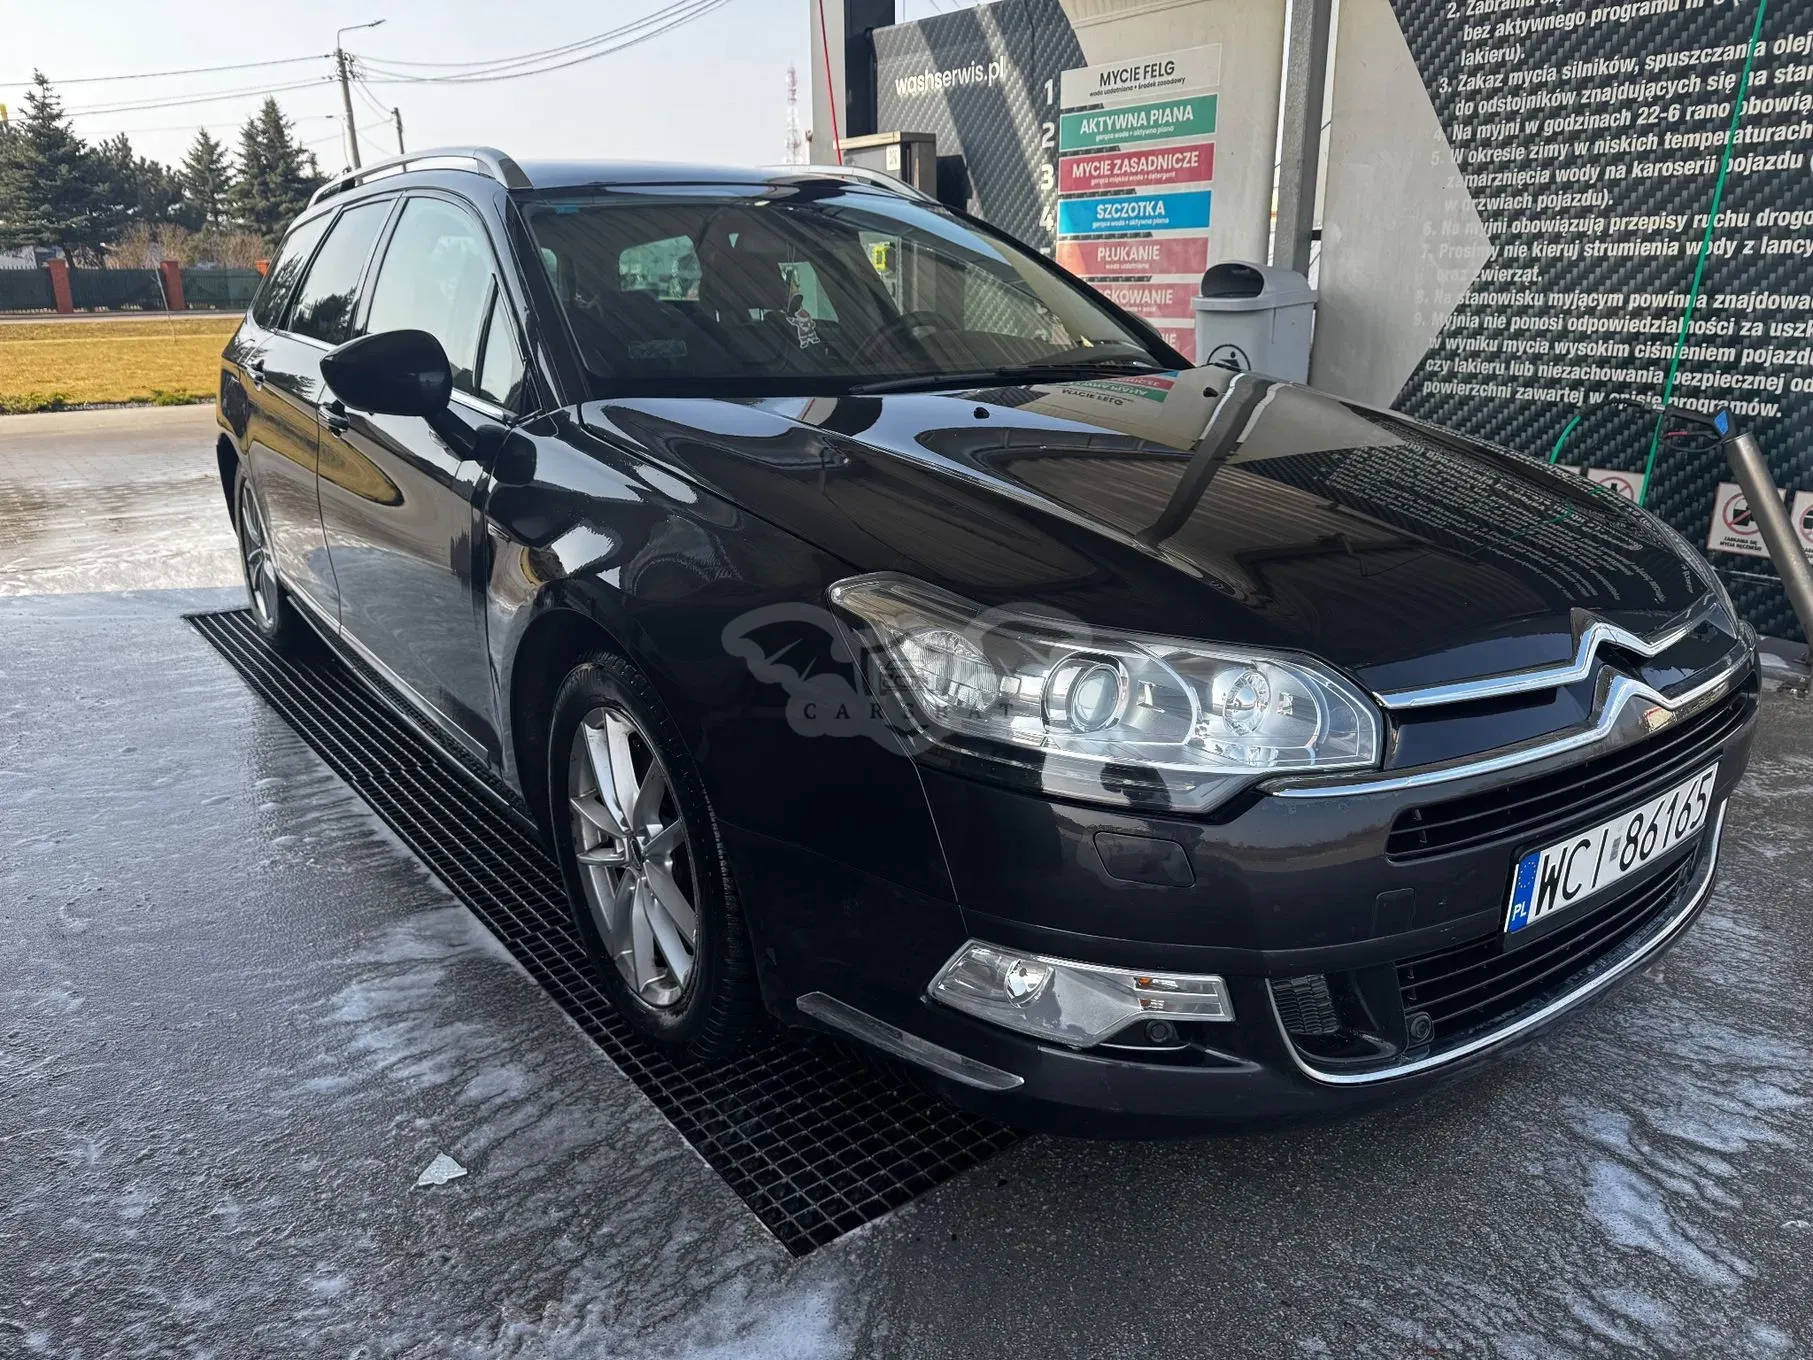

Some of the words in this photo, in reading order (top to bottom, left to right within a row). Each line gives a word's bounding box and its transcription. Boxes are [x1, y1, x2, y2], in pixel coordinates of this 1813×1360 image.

[1446, 2, 1460, 19] 2.
[1463, 24, 1492, 41] bez
[1495, 11, 1587, 37] aktywnego
[1590, 0, 1680, 27] programu
[1439, 77, 1452, 94] 3.
[1457, 73, 1504, 92] Zakaz
[1508, 65, 1557, 88] mycia
[1561, 56, 1640, 81] silników,
[1645, 39, 1767, 73] spuszczania
[1773, 29, 1813, 56] olej
[1460, 43, 1526, 66] lakieru).
[895, 55, 1005, 96] washserwis.pl
[1099, 66, 1141, 87] MYCIE
[1143, 60, 1176, 80] FELG
[1044, 79, 1054, 105] 1
[1455, 99, 1474, 116] do
[1478, 87, 1576, 113] odstojników
[1581, 74, 1702, 103] znajdujących
[1707, 71, 1737, 93] się
[1080, 111, 1148, 135] AKTYWNA
[1150, 105, 1194, 125] PIANA
[1452, 124, 1472, 140] Na
[1477, 118, 1521, 140] myjni
[1525, 120, 1540, 134] w
[1543, 110, 1632, 136] godzinach
[1636, 103, 1680, 125] 22-6
[1685, 102, 1731, 121] rano
[1740, 92, 1813, 116] obowią
[1041, 122, 1055, 148] 2
[1451, 148, 1464, 164] W
[1468, 144, 1525, 164] okresie
[1529, 141, 1570, 160] zimy
[1574, 141, 1590, 156] w
[1593, 132, 1658, 154] niskich
[1664, 120, 1813, 151] temperaturach
[1040, 164, 1055, 190] 3
[1072, 160, 1111, 178] MYCIE
[1114, 151, 1199, 173] ZASADNICZE
[1555, 163, 1600, 184] wody
[1605, 164, 1626, 180] na
[1631, 155, 1716, 179] karoserii
[1097, 200, 1165, 219] SZCZOTKA
[1536, 188, 1614, 212] pojazdu).
[1039, 206, 1054, 231] 4
[1511, 214, 1604, 237] obowiązują
[1609, 211, 1688, 234] przepisy
[1692, 209, 1750, 228] ruchu
[1097, 245, 1161, 261] PŁUKANIE
[1503, 244, 1528, 258] nie
[1532, 240, 1580, 260] kieruj
[1583, 238, 1679, 257] strumienia
[1743, 239, 1756, 254] z
[1473, 265, 1543, 285] zwierząt.
[1100, 289, 1173, 305] SKOWANIE
[1456, 290, 1544, 306] stanowisku
[1548, 290, 1624, 311] myjącym
[1628, 290, 1708, 311] powinna
[1713, 291, 1813, 312] znajdowa
[1483, 314, 1507, 329] nie
[1510, 314, 1564, 332] ponosi
[1567, 314, 1736, 336] odpowiedzialności
[1739, 321, 1764, 336] za
[1429, 336, 1442, 350] w
[1445, 335, 1498, 353] wyniku
[1502, 337, 1550, 356] mycia
[1554, 339, 1630, 357] wysokim
[1634, 340, 1736, 362] ciśnieniem
[1426, 359, 1450, 374] czy
[1454, 358, 1505, 375] lakieru
[1509, 361, 1534, 376] lub
[1538, 362, 1665, 385] niezachowania
[1672, 369, 1785, 394] bezpiecznej
[1422, 380, 1512, 397] powierzchni
[1515, 384, 1586, 407] zawartej
[1589, 391, 1605, 404] w
[1534, 828, 1609, 917] WCI
[1619, 770, 1714, 873] 86165
[1511, 903, 1527, 922] PL
